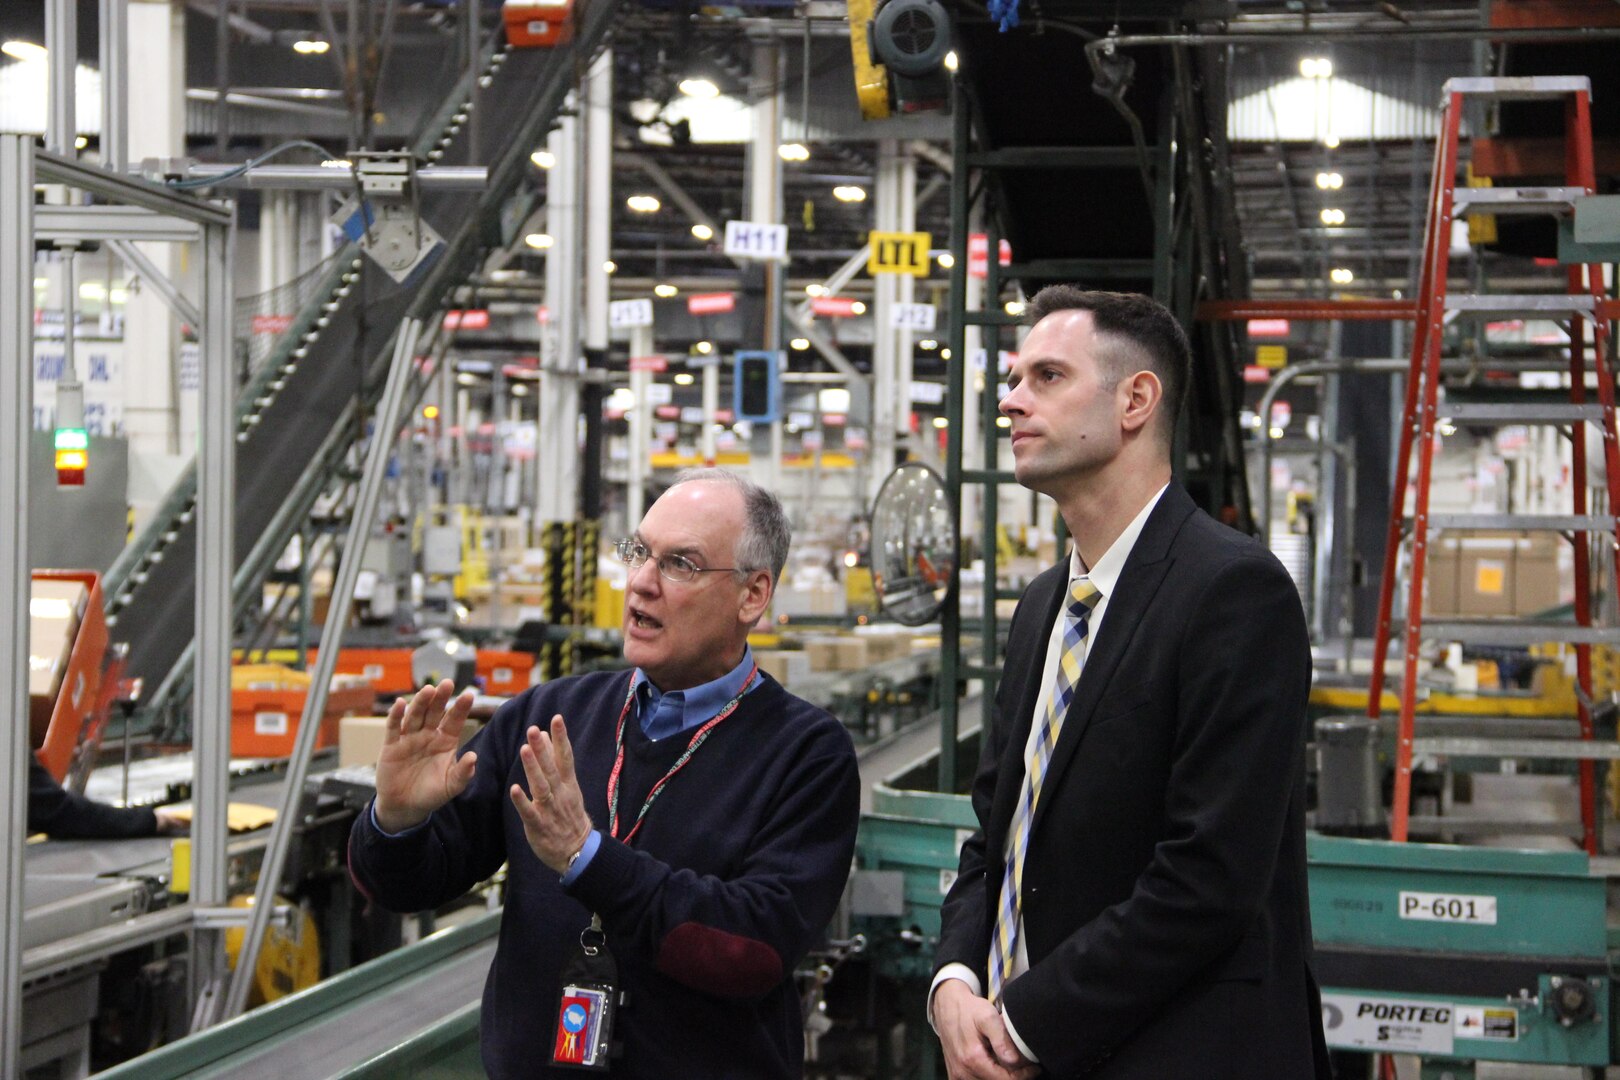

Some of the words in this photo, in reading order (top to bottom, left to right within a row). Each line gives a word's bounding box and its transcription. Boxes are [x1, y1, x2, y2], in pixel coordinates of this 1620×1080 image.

[733, 229, 779, 251] H11
[877, 239, 922, 267] LTL
[1404, 896, 1479, 919] P-601
[1357, 1002, 1451, 1024] PORTEC
